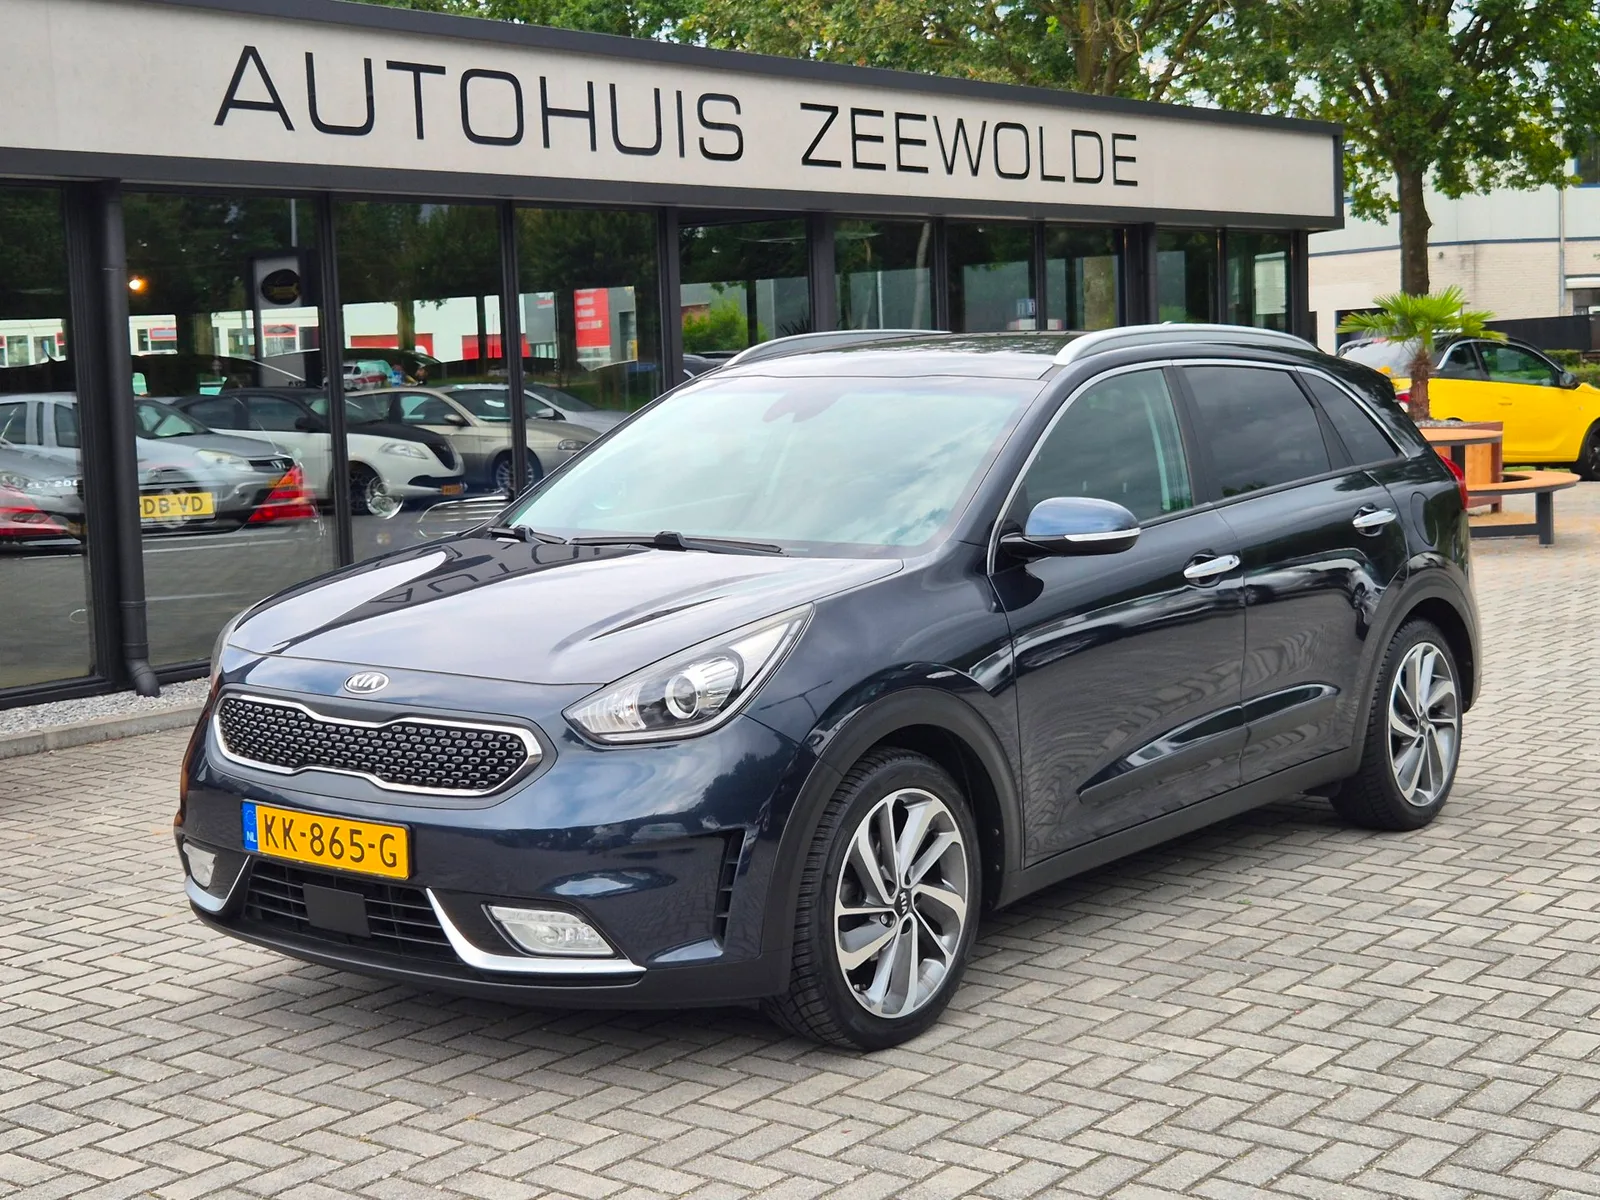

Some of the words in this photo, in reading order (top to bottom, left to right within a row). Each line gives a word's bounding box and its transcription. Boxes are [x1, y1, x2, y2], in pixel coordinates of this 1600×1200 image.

[214, 45, 744, 162] AUTOHUIS
[800, 102, 1138, 187] ZEEWOLDE
[140, 496, 204, 515] DB-VD
[246, 831, 257, 843] NL
[264, 814, 398, 868] KK-865-G
